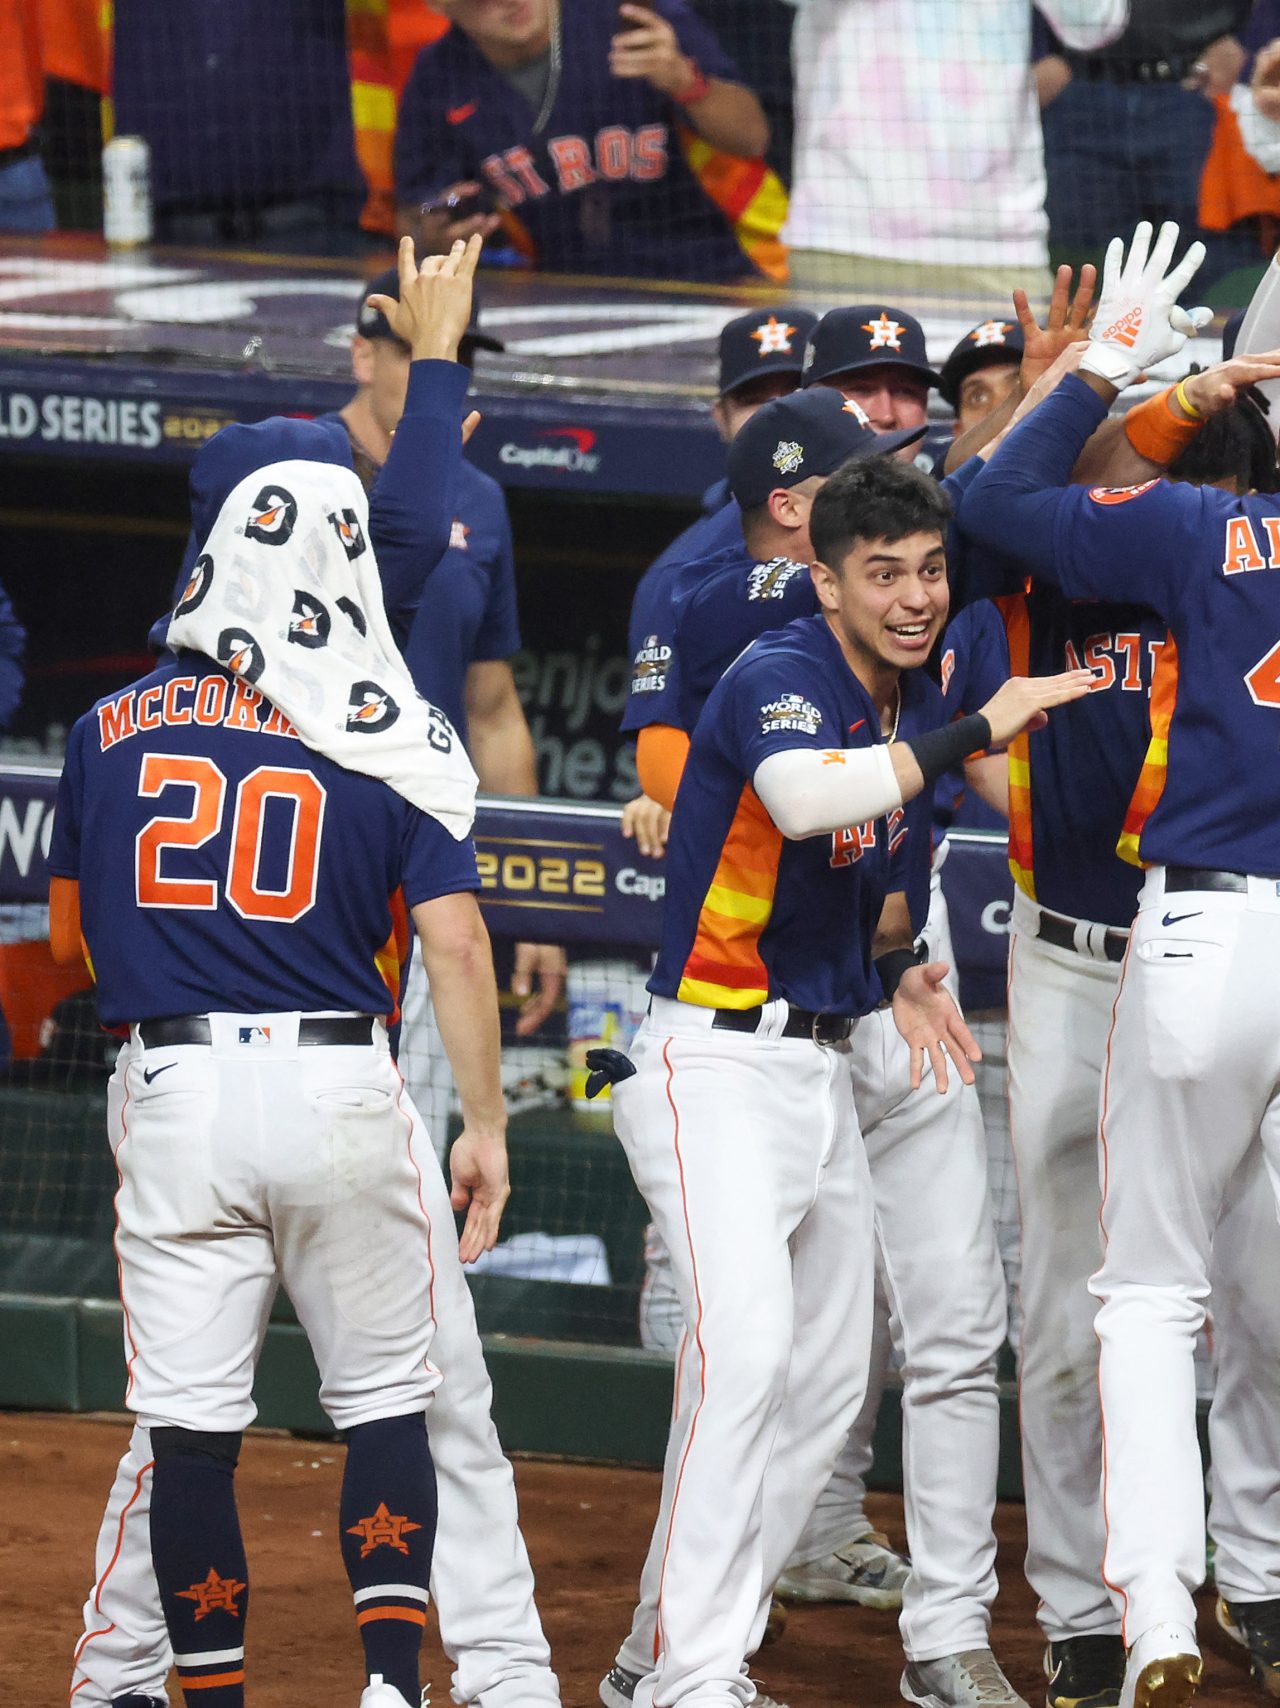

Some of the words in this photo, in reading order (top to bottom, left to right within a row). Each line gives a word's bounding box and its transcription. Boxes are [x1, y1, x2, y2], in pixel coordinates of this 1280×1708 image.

[1102, 306, 1142, 340] adidas
[41, 394, 162, 448] SERIES
[634, 645, 672, 665] WORLD
[760, 701, 822, 719] WORLD
[761, 719, 817, 736] SERIES
[135, 752, 327, 924] 20
[476, 854, 605, 897] 2022
